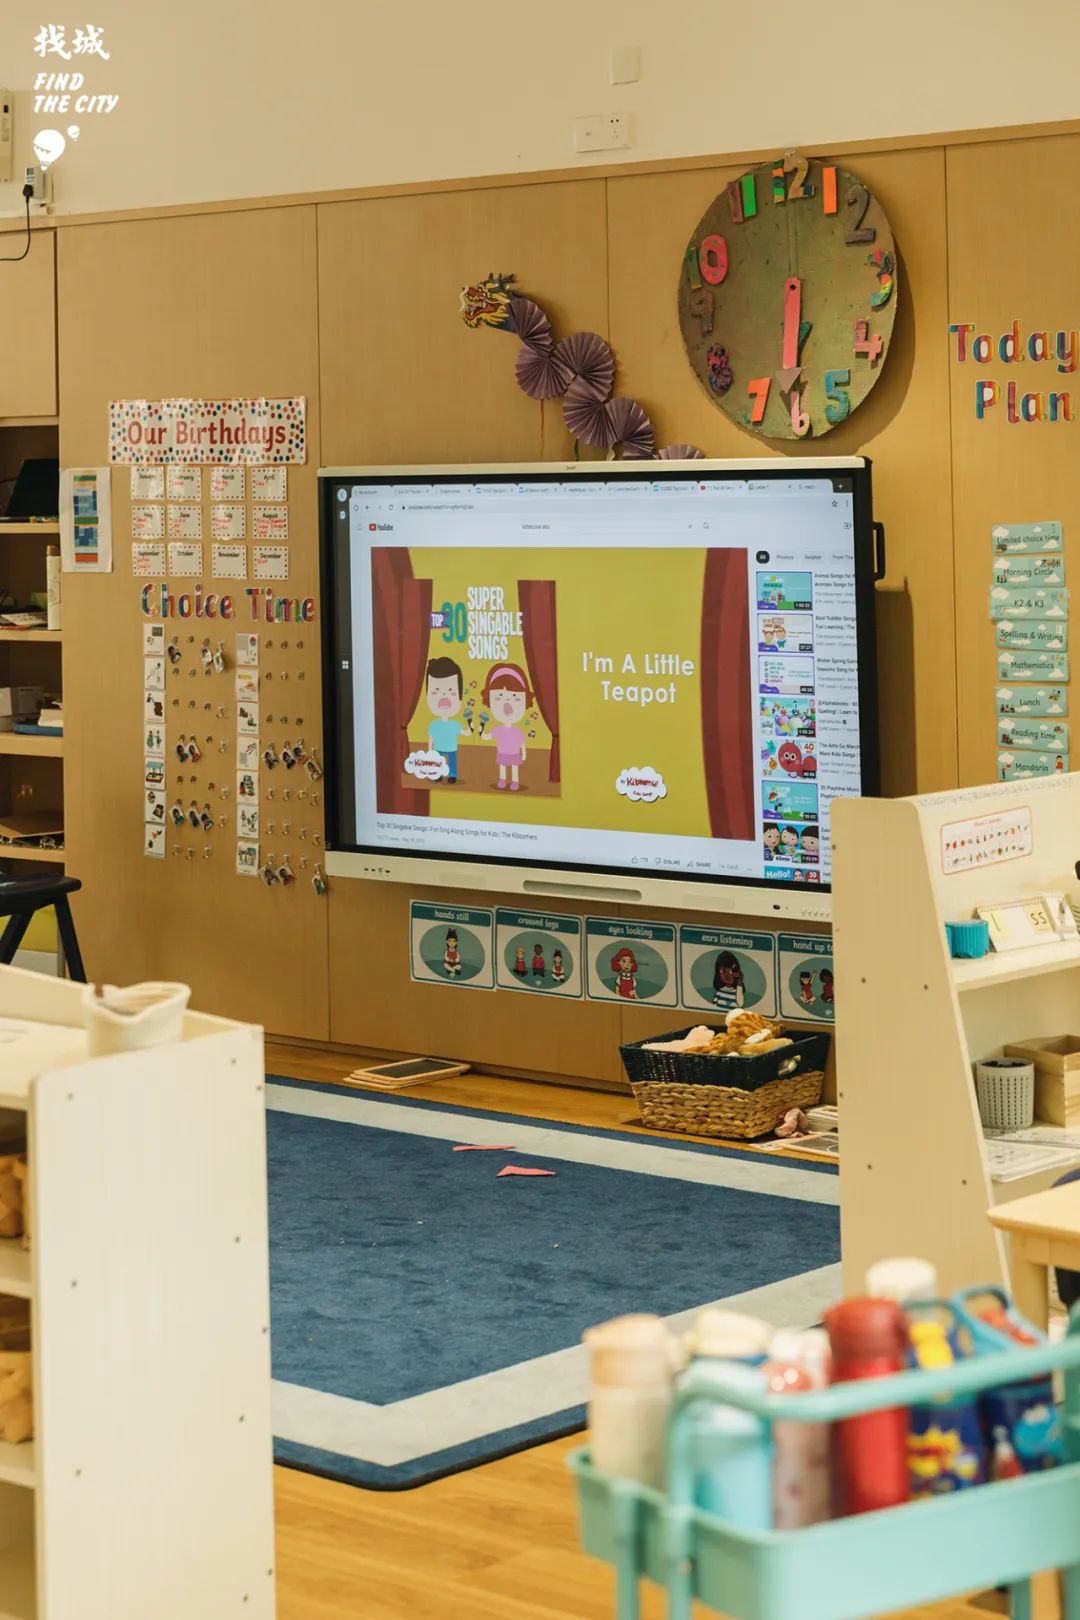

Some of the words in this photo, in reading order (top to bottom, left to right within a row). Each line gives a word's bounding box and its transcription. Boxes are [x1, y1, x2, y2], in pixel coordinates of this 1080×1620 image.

[844, 184, 876, 244] 2
[865, 249, 895, 307] 3
[854, 320, 884, 362] 4
[949, 319, 1080, 373] Today
[706, 342, 734, 393] 8
[748, 376, 773, 423] 7
[825, 368, 851, 423] 5
[975, 379, 1076, 424] Plan
[790, 391, 811, 436] 6
[127, 420, 167, 445] Our
[176, 417, 287, 452] Birthdays
[1003, 567, 1032, 578] Morning
[1033, 567, 1055, 576] Circle
[141, 583, 233, 620] Choice
[245, 586, 318, 624] Time
[466, 585, 505, 612] SUPER
[1014, 599, 1024, 608] K2
[1026, 600, 1032, 608] &
[1034, 599, 1044, 608] K3
[430, 613, 444, 628] TOP
[441, 600, 467, 643] 30
[467, 611, 524, 636] SINGABLE
[468, 635, 509, 661] SONGS
[1000, 629, 1028, 641] Spelling
[1037, 632, 1064, 643] Writing
[582, 651, 614, 673] I'm
[621, 653, 637, 674] A
[644, 653, 695, 676] Little
[1010, 661, 1055, 670] Mathematics
[600, 680, 676, 707] Teapot
[1019, 698, 1041, 707] Lunch
[1011, 728, 1039, 740] Reading
[1040, 731, 1057, 740] time
[1015, 763, 1049, 772] Mandarin
[465, 827, 480, 837] Songs
[488, 829, 500, 837] Kids
[766, 869, 791, 880] Hello!
[434, 909, 456, 920] hands
[456, 911, 470, 921] still
[517, 917, 544, 927] crossed
[544, 919, 560, 930] legs
[608, 925, 625, 936] eyes
[625, 926, 653, 938] looking
[701, 934, 719, 942] ears
[719, 935, 753, 948] listening
[793, 940, 812, 950] hand
[814, 943, 826, 952] up
